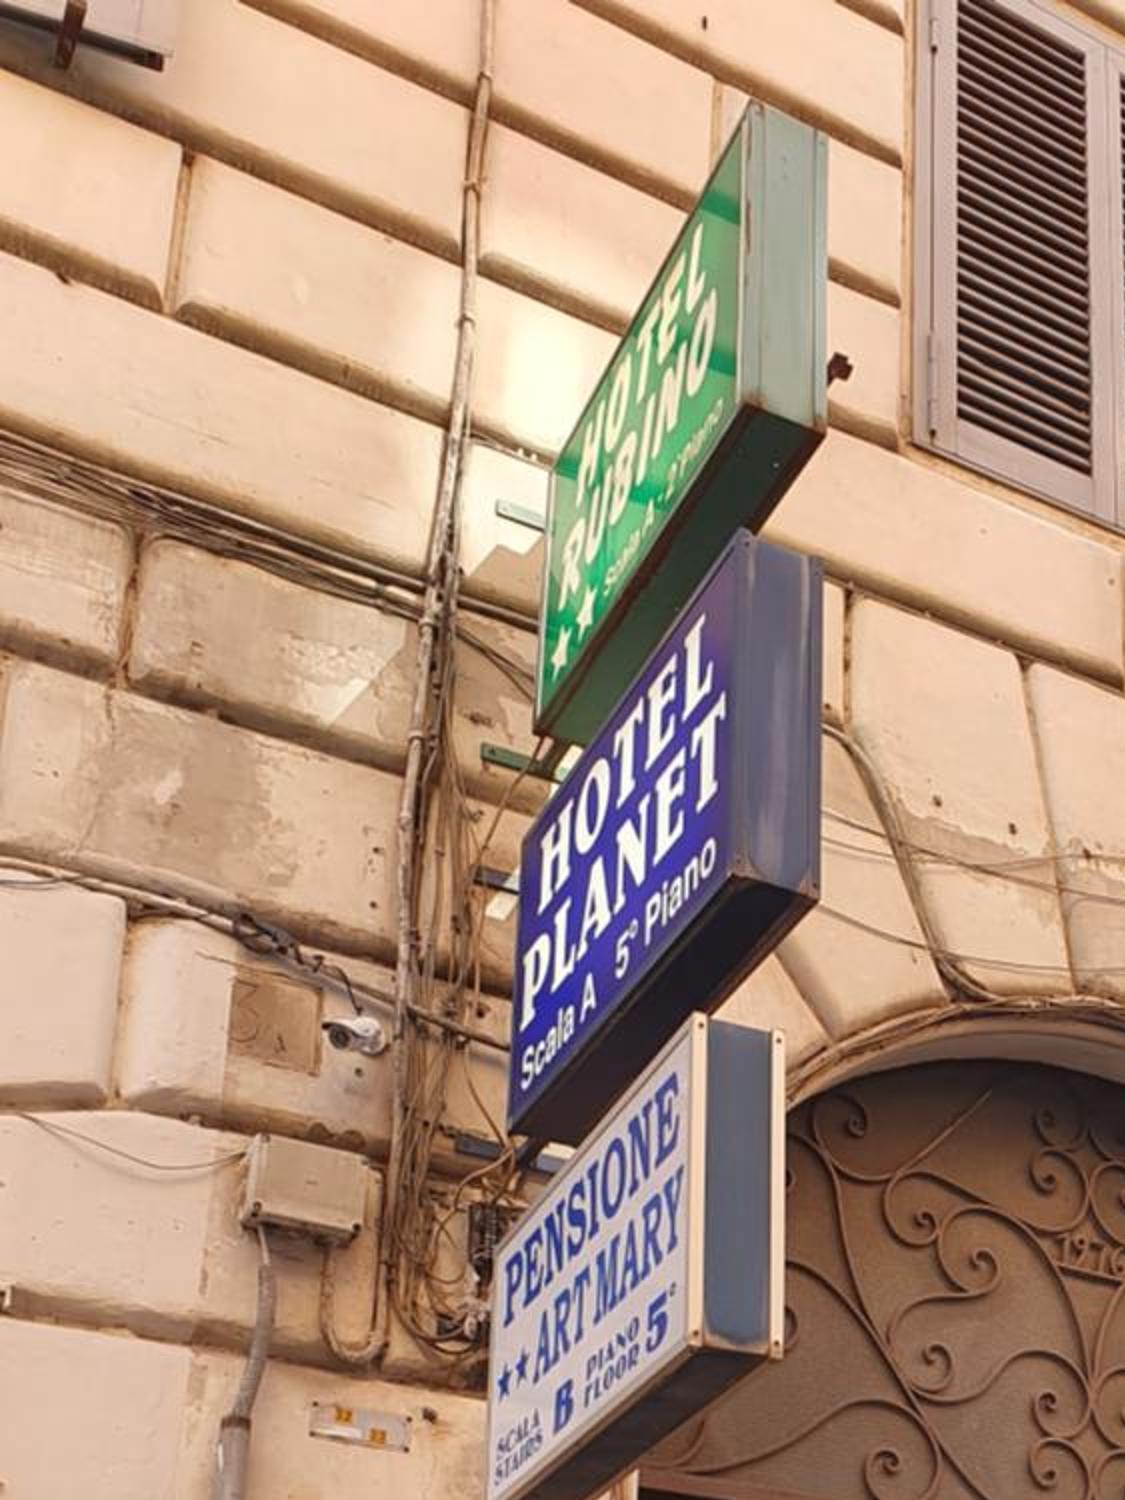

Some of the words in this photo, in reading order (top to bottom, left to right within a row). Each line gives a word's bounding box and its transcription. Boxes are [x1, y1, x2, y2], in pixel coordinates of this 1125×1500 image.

[560, 288, 718, 612] RUBINO
[575, 222, 706, 508] HOTEL
[519, 692, 727, 1032] PLANET
[537, 613, 715, 917] HOTEL
[520, 1010, 576, 1091] Scala
[579, 972, 598, 1026] A
[643, 837, 718, 950] Piano
[503, 1071, 682, 1328] PENSIONE
[533, 1267, 593, 1385] ART
[596, 1164, 686, 1321] MARY
[493, 1431, 544, 1487] STAIRS
[497, 1408, 541, 1456] SCALA
[553, 1375, 575, 1440] B
[583, 1343, 641, 1409] FLOOR
[586, 1316, 641, 1381] PIANO
